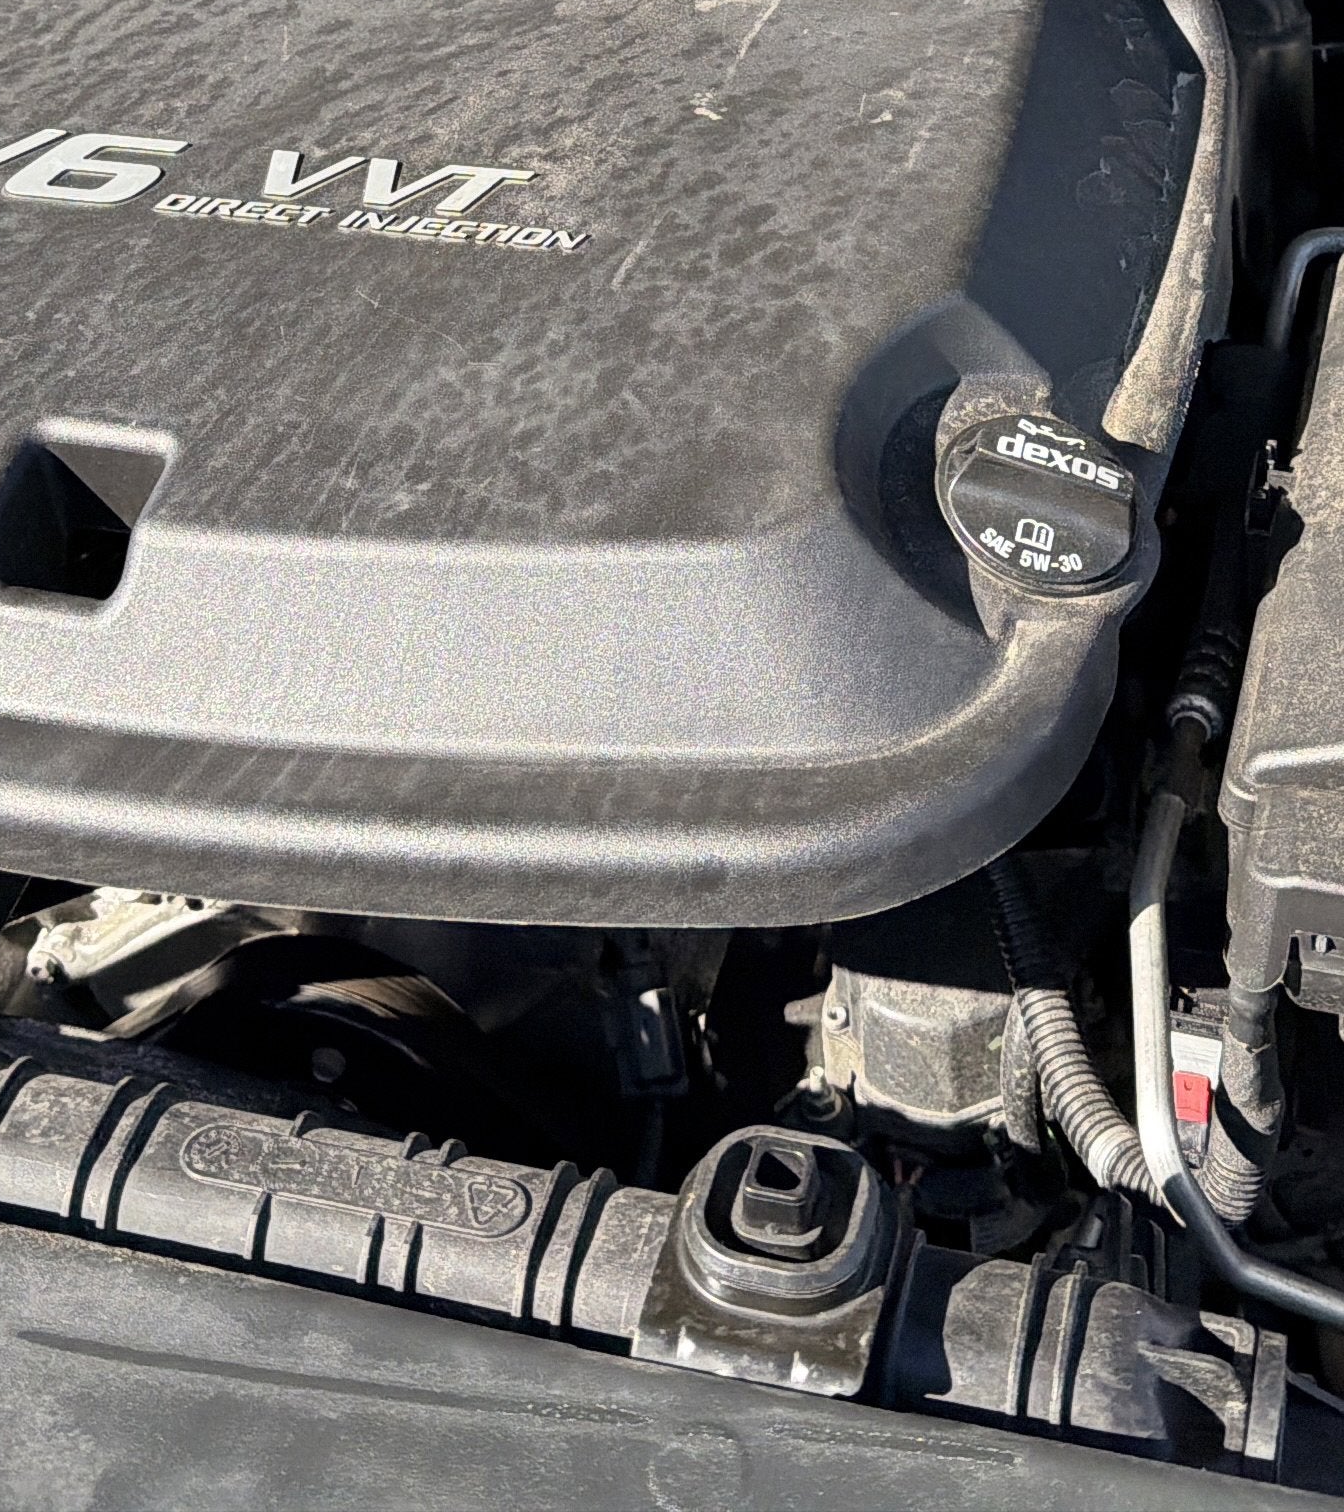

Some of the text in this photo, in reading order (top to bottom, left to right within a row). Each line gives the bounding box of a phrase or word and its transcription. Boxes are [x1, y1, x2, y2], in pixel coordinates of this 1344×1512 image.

[263, 148, 536, 215] VVT
[154, 192, 592, 251] DIRECT INJECTION
[996, 433, 1125, 490] dexos
[979, 527, 1083, 573] SAE 5W-30
